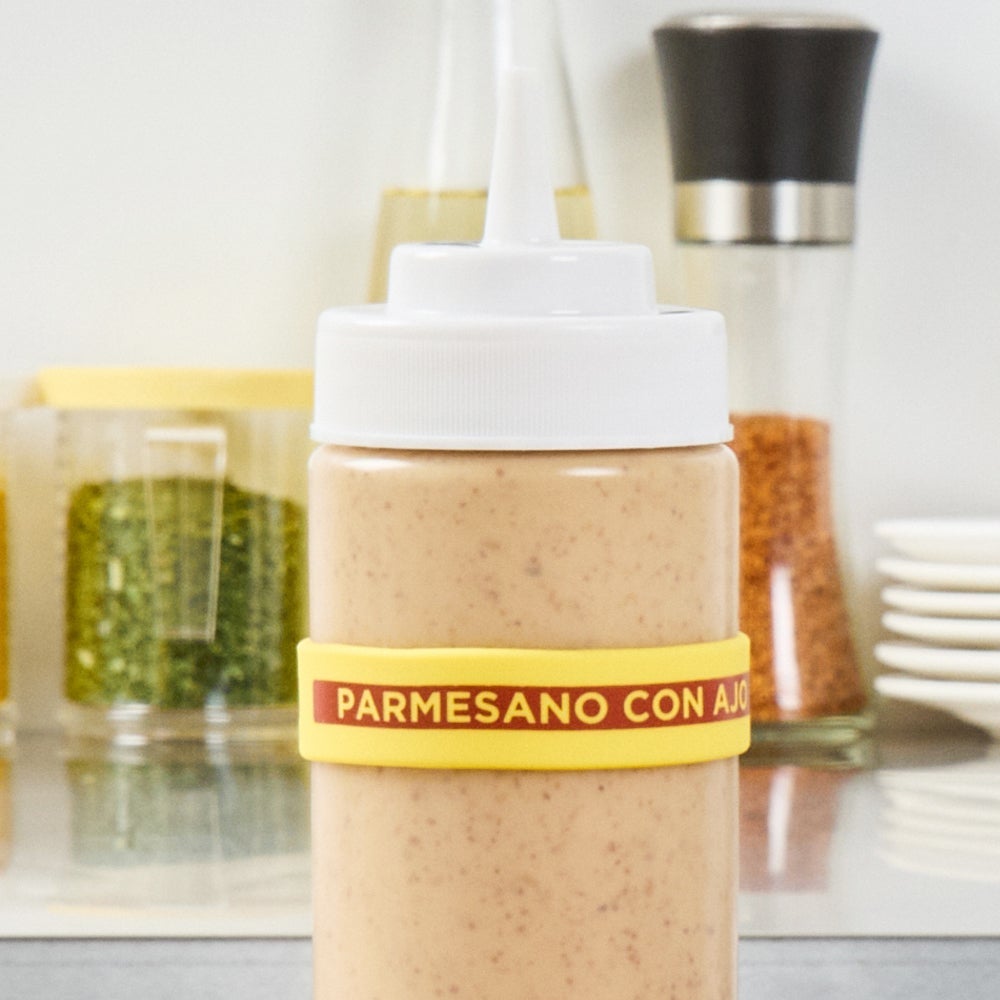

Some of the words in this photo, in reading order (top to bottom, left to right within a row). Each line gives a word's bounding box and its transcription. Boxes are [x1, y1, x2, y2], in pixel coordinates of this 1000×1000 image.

[337, 687, 608, 725] PARMESANO
[623, 685, 704, 722] CON
[712, 680, 748, 716] AJO
